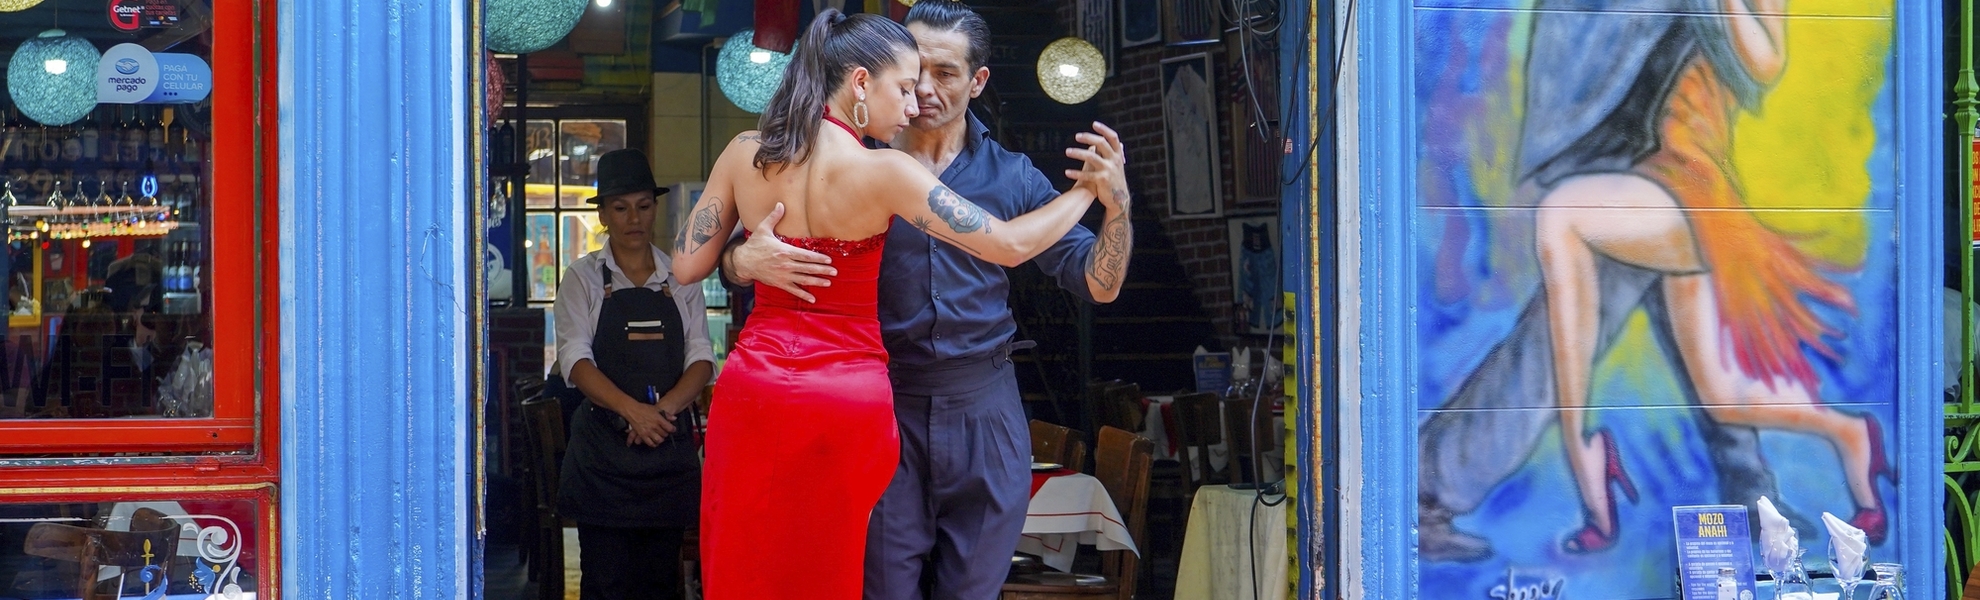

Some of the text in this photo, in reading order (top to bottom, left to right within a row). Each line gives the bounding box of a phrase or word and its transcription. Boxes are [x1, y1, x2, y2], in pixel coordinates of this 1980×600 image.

[113, 5, 141, 13] Getnet
[108, 77, 146, 85] mercado
[163, 73, 184, 81] CON
[116, 84, 138, 93] pago
[163, 82, 204, 90] CELULAR
[1698, 513, 1725, 525] MOZO
[1698, 525, 1728, 538] ANAHI
